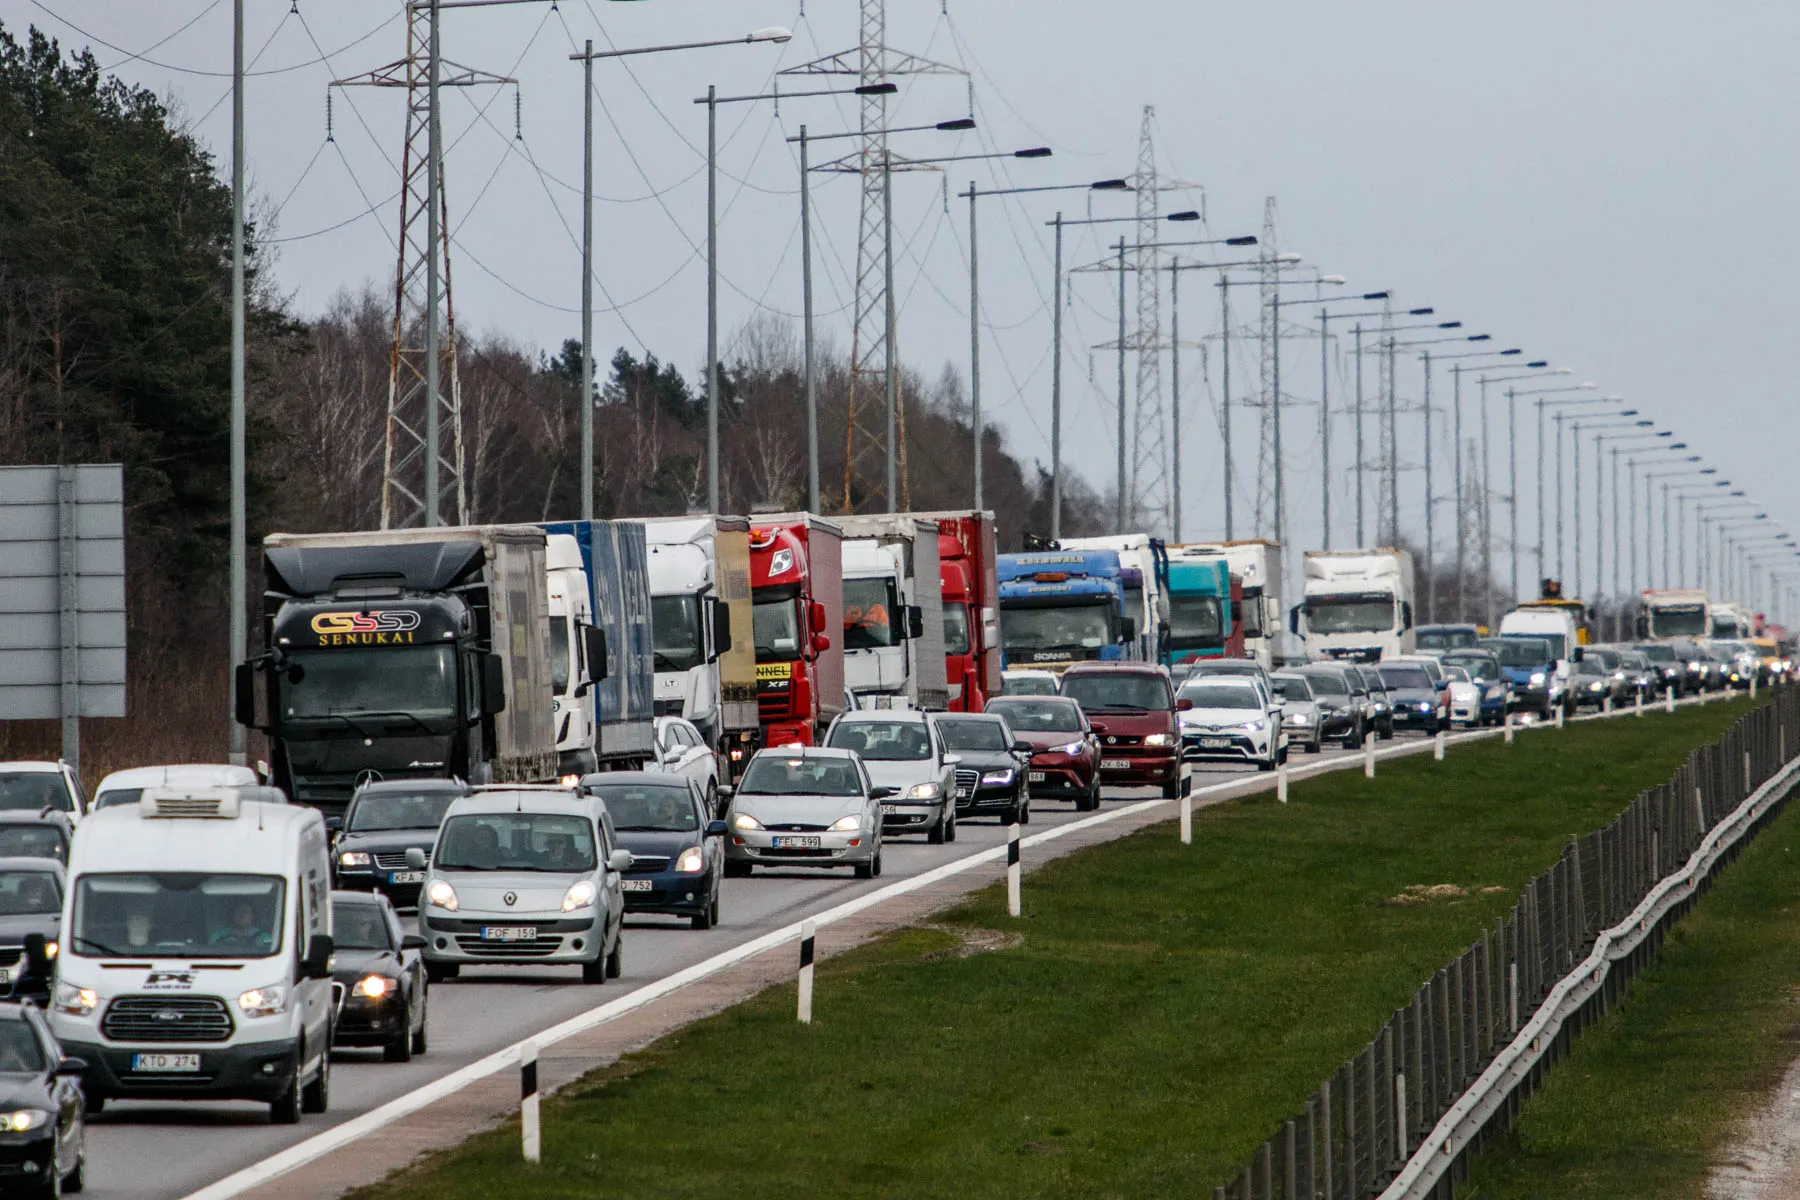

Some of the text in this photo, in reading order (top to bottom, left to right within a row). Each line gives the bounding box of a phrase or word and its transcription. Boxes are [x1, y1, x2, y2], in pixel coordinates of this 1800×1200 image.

[319, 632, 414, 646] SENUKAI
[1033, 652, 1072, 661] SCANIA
[664, 680, 676, 688] LT
[778, 837, 818, 846] FEL 599
[394, 872, 415, 882] KFA
[633, 881, 650, 890] 752
[517, 928, 536, 938] 159
[140, 1055, 197, 1067] KTD 274
